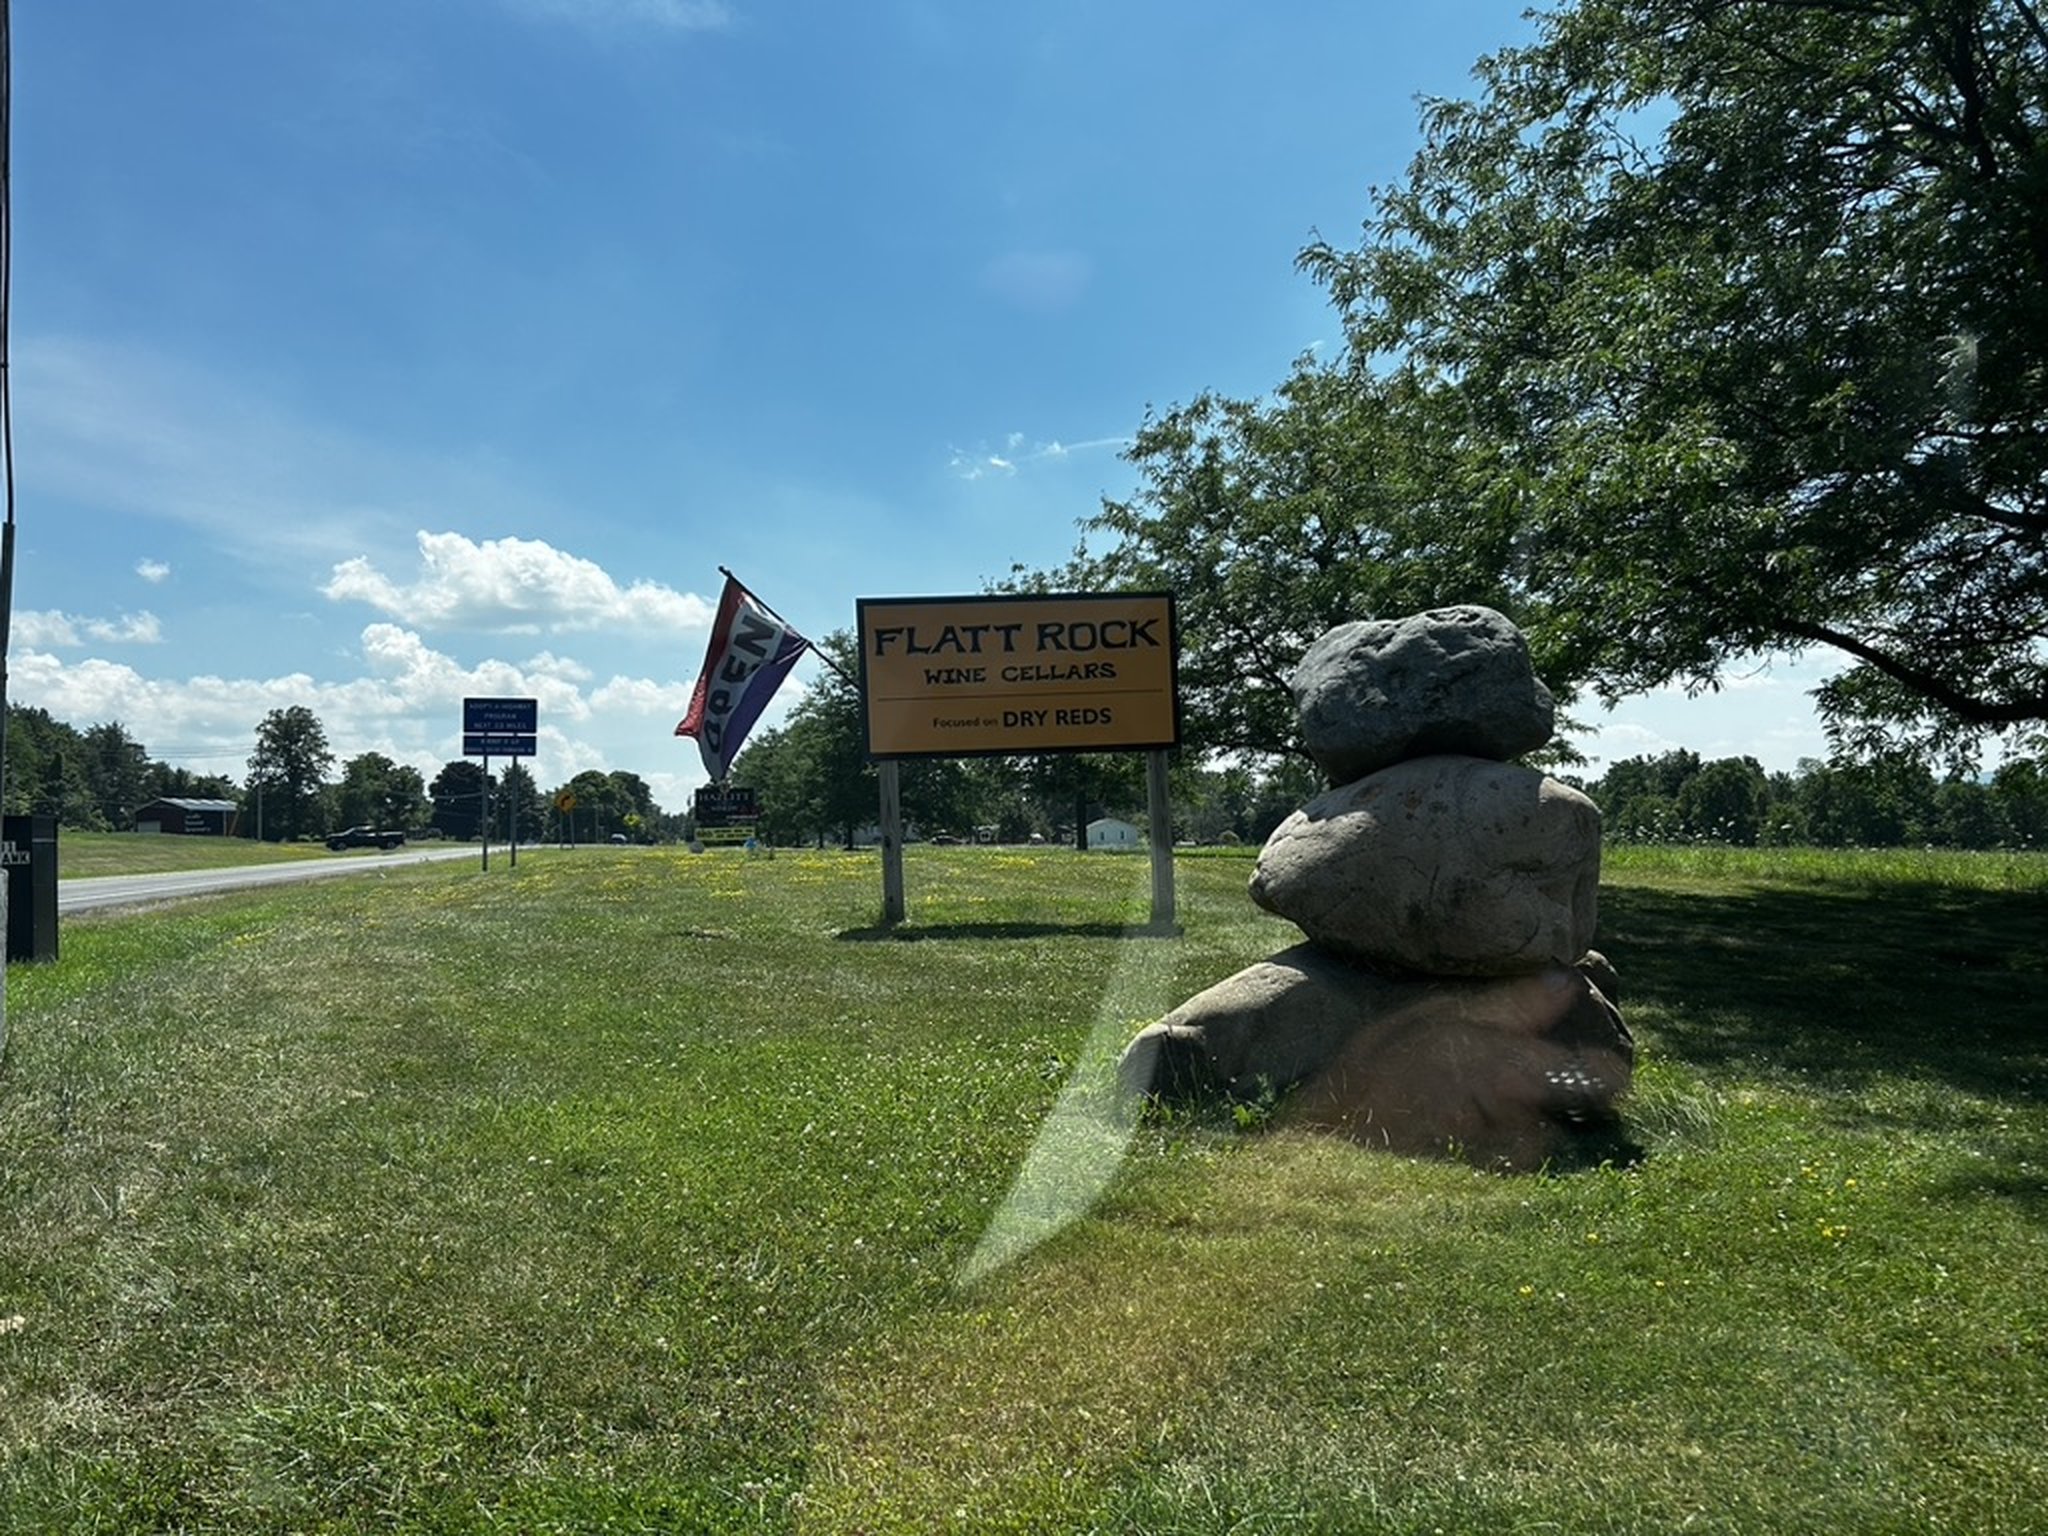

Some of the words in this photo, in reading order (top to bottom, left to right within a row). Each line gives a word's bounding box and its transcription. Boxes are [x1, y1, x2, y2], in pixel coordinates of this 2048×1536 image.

[874, 623, 1023, 656] FLATT
[1036, 618, 1162, 652] ROCK
[703, 614, 777, 754] OPEN
[923, 667, 987, 685] WINE
[1001, 662, 1118, 683] CELLARS
[932, 717, 980, 729] Focused
[983, 718, 999, 727] on
[1003, 710, 1049, 728] DRY
[1055, 707, 1113, 726] REDS
